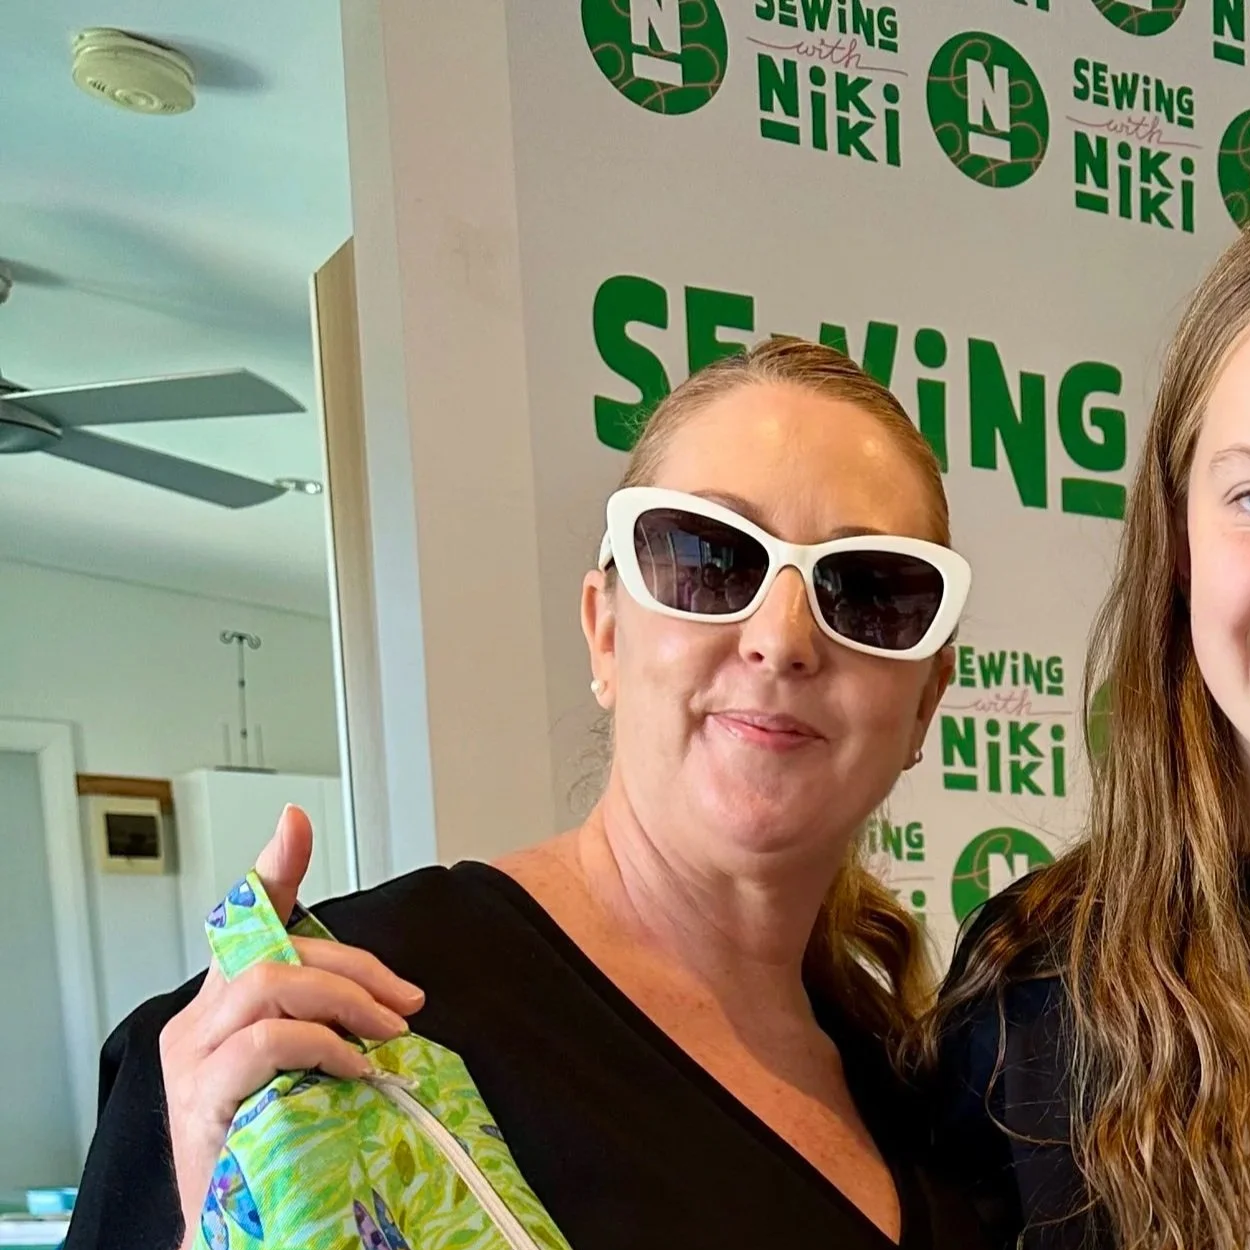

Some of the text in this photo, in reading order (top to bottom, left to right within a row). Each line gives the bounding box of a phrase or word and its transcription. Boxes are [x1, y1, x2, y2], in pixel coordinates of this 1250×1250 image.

[629, 0, 683, 87] N
[746, 36, 908, 77] with
[966, 58, 1012, 163] N
[1065, 115, 1203, 149] with
[950, 645, 1065, 696] EWiNG
[940, 693, 1073, 717] with
